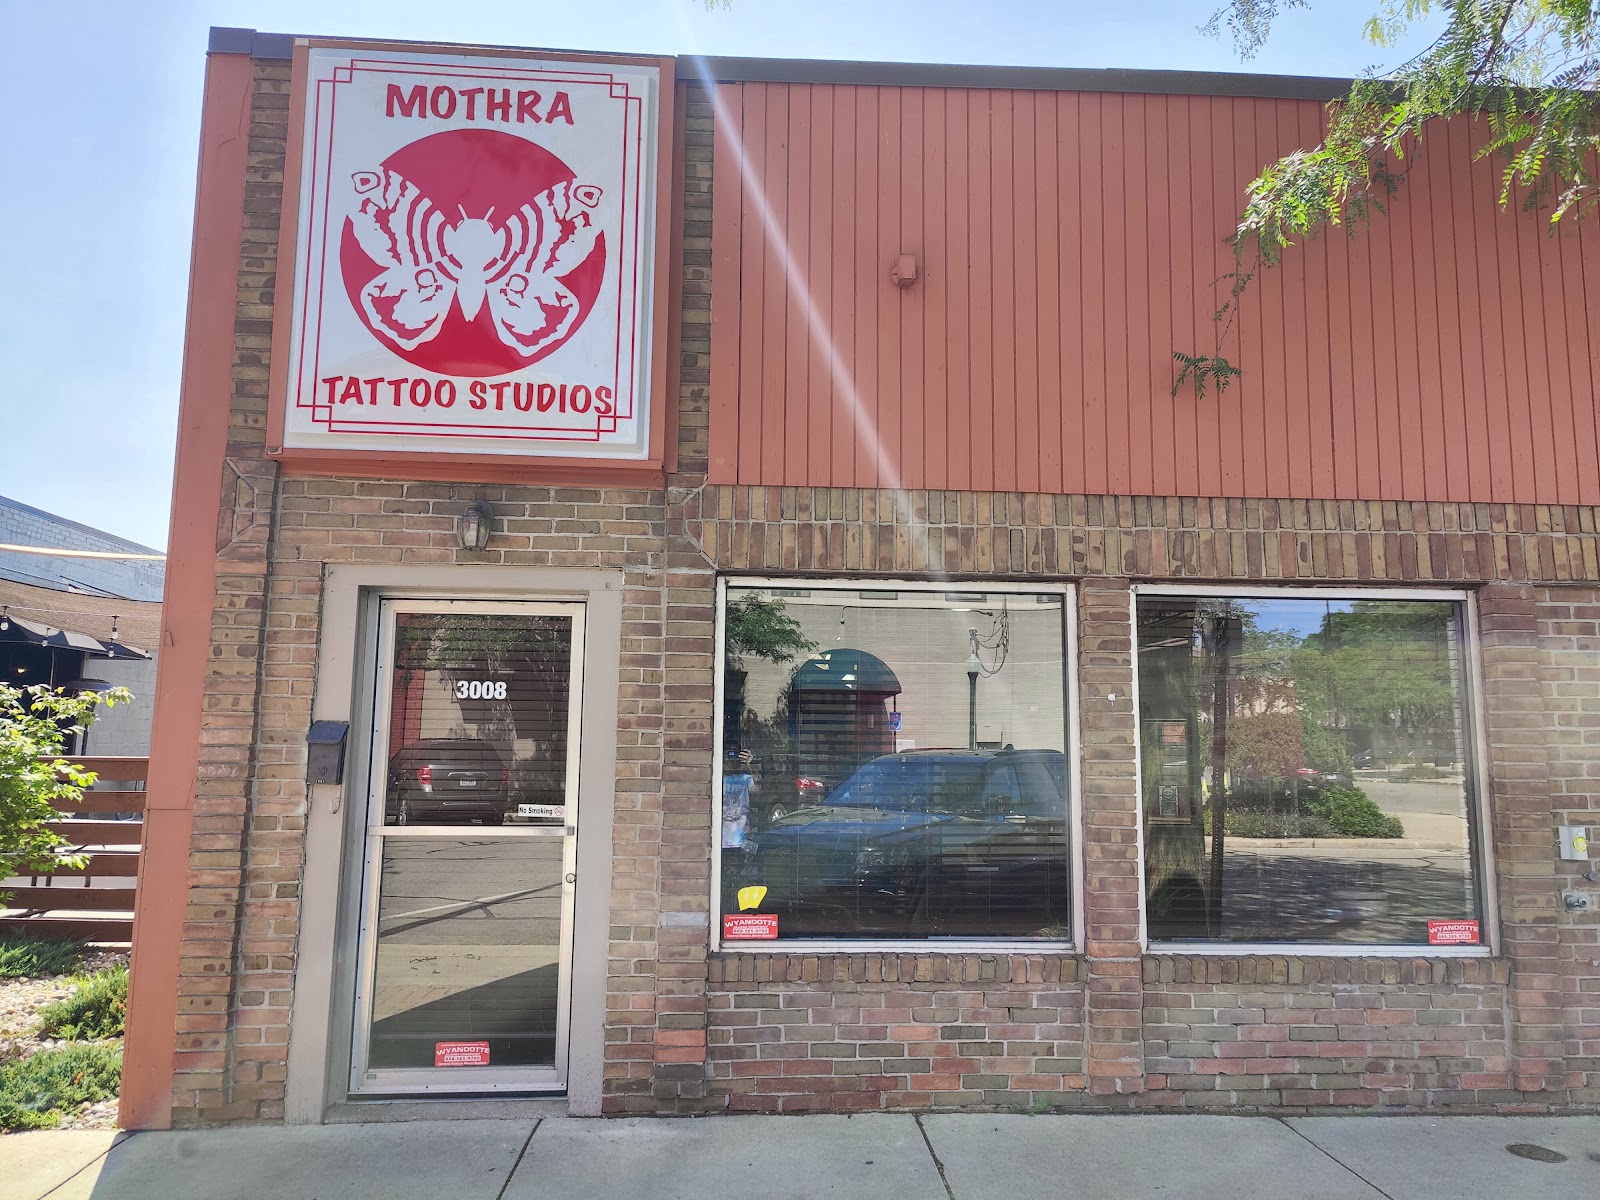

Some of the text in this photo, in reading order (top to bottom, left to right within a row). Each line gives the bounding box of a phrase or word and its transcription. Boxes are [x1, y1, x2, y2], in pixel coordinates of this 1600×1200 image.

[386, 83, 575, 126] MOTHRA
[322, 376, 612, 414] TATTOO STUDIOS
[456, 680, 507, 700] 3008
[519, 806, 553, 816] No Smoking
[724, 919, 777, 928] WYANDOTTE
[1429, 925, 1479, 934] WYANDOTTE
[436, 1046, 490, 1056] WYANDOTTE
